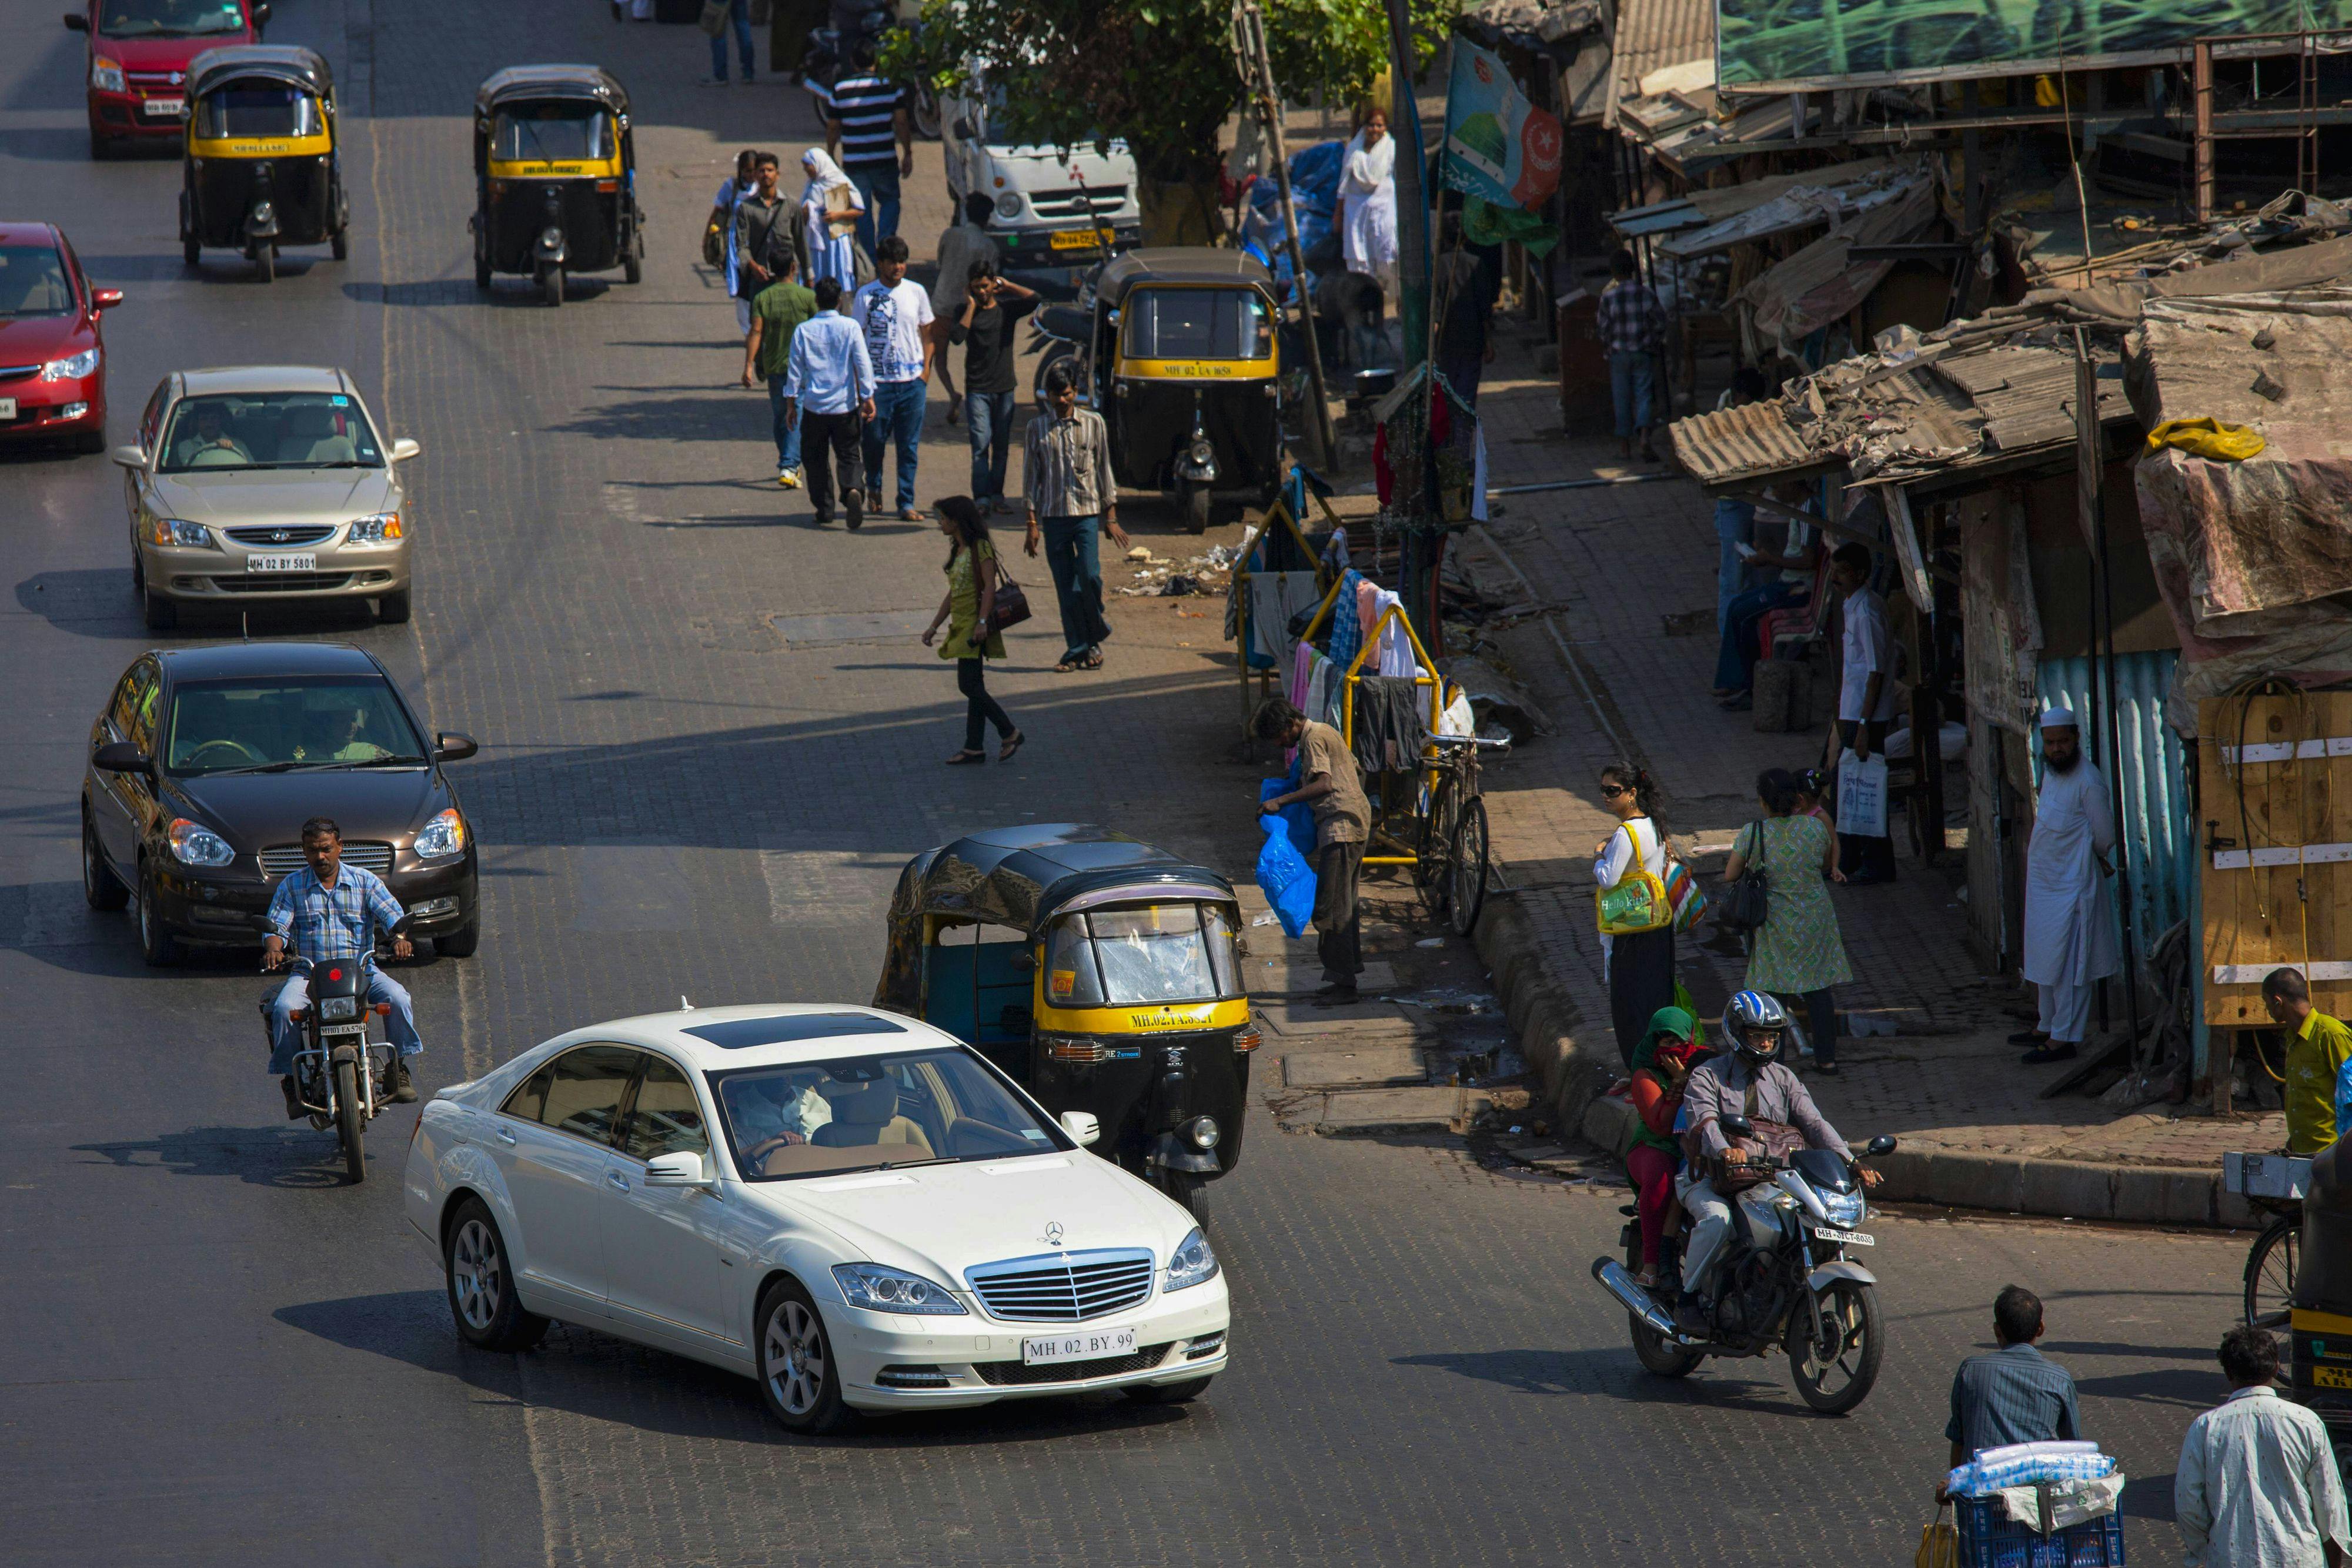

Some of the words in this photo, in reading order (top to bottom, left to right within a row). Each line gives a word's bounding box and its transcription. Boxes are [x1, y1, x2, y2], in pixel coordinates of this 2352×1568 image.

[250, 559, 263, 569] MH
[266, 559, 276, 569] 02
[280, 559, 290, 569] BY
[294, 558, 315, 569] 5801
[1602, 898, 1624, 910] Hello
[351, 1024, 365, 1032] 5704
